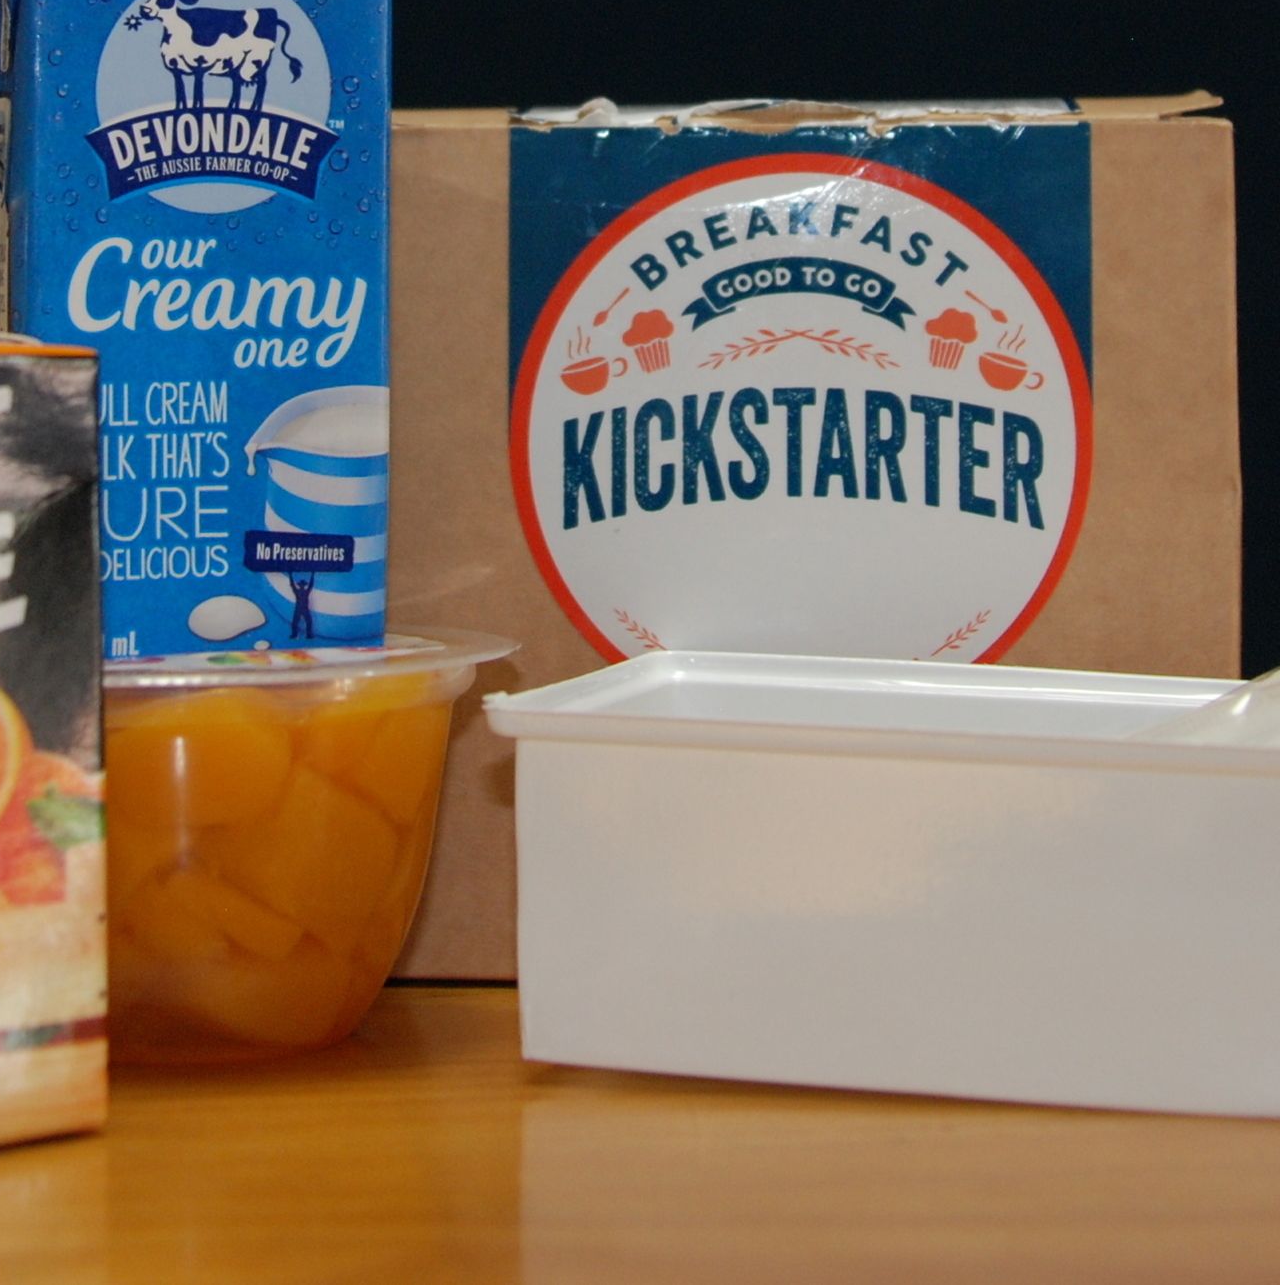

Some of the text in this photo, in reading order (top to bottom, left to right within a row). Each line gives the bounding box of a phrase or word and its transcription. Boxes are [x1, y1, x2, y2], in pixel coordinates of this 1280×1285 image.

[106, 111, 318, 171] DEVONDALE
[135, 155, 290, 183] THE AUSSIE FARMER CO-OP
[140, 237, 217, 269] our
[630, 201, 970, 292] BREAKFAST
[66, 236, 368, 368] Creamy
[716, 266, 882, 298] GOOD TO GO
[233, 336, 310, 369] one
[145, 381, 228, 426] CREAM
[103, 431, 230, 481] LK THAT'S
[562, 385, 1046, 531] KICKSTARTER
[103, 485, 229, 542] URE
[256, 542, 345, 562] No Preservatives
[111, 630, 140, 657] mL
